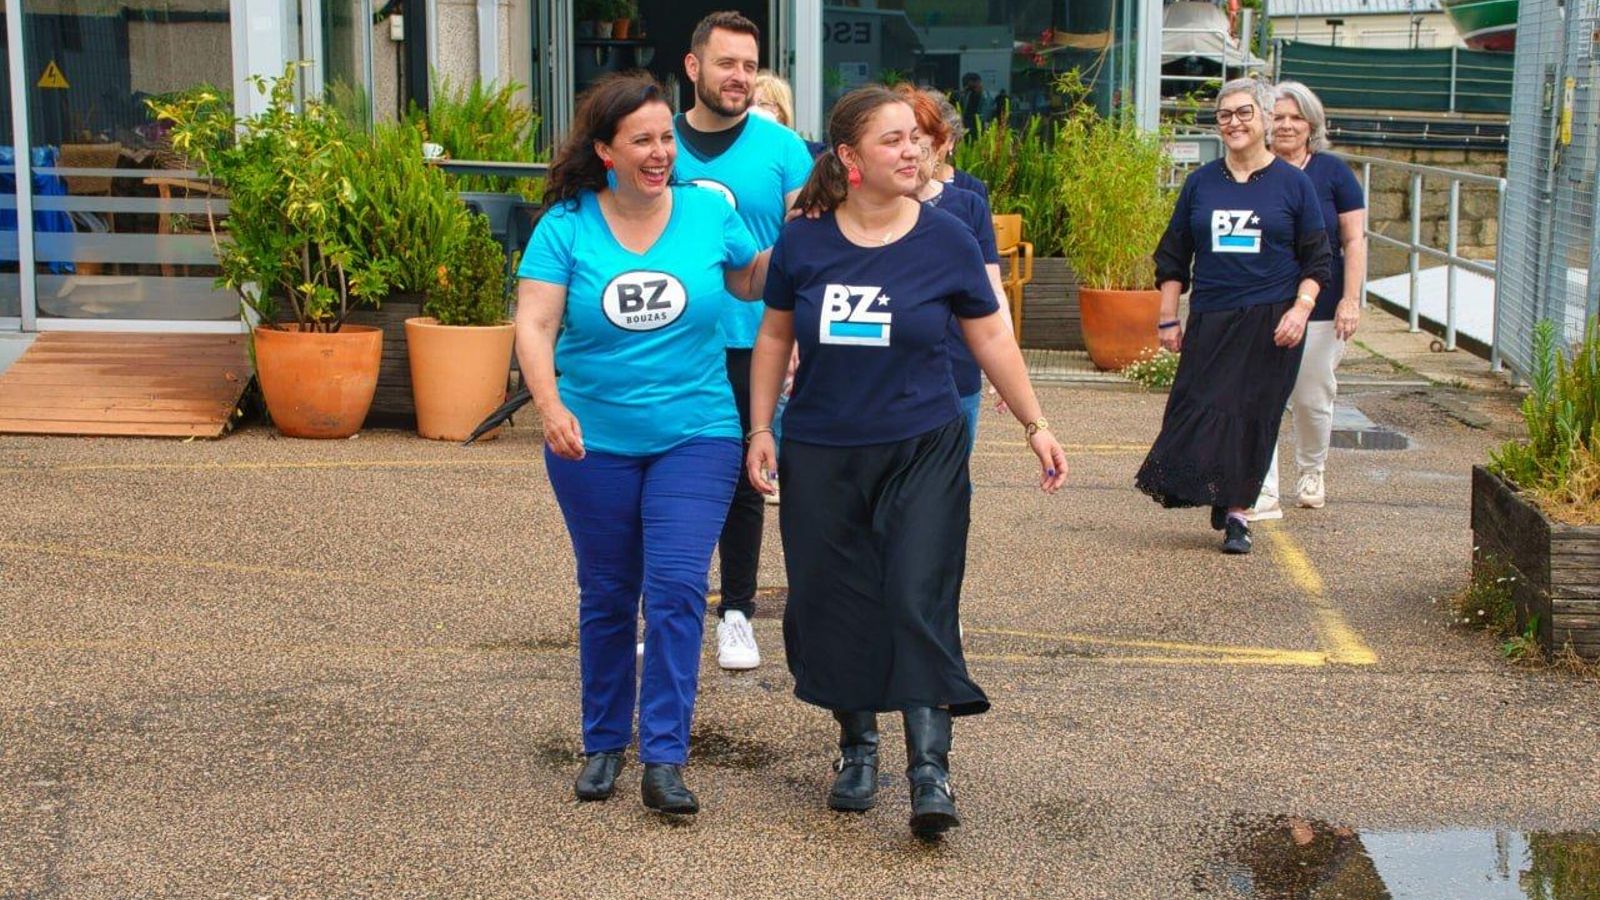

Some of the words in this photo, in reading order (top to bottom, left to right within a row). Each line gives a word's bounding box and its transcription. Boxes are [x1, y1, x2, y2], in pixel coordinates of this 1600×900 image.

[1212, 209, 1262, 238] BZ
[617, 279, 672, 314] BZ
[820, 284, 892, 325] BZ
[626, 312, 667, 324] BOUZAS
